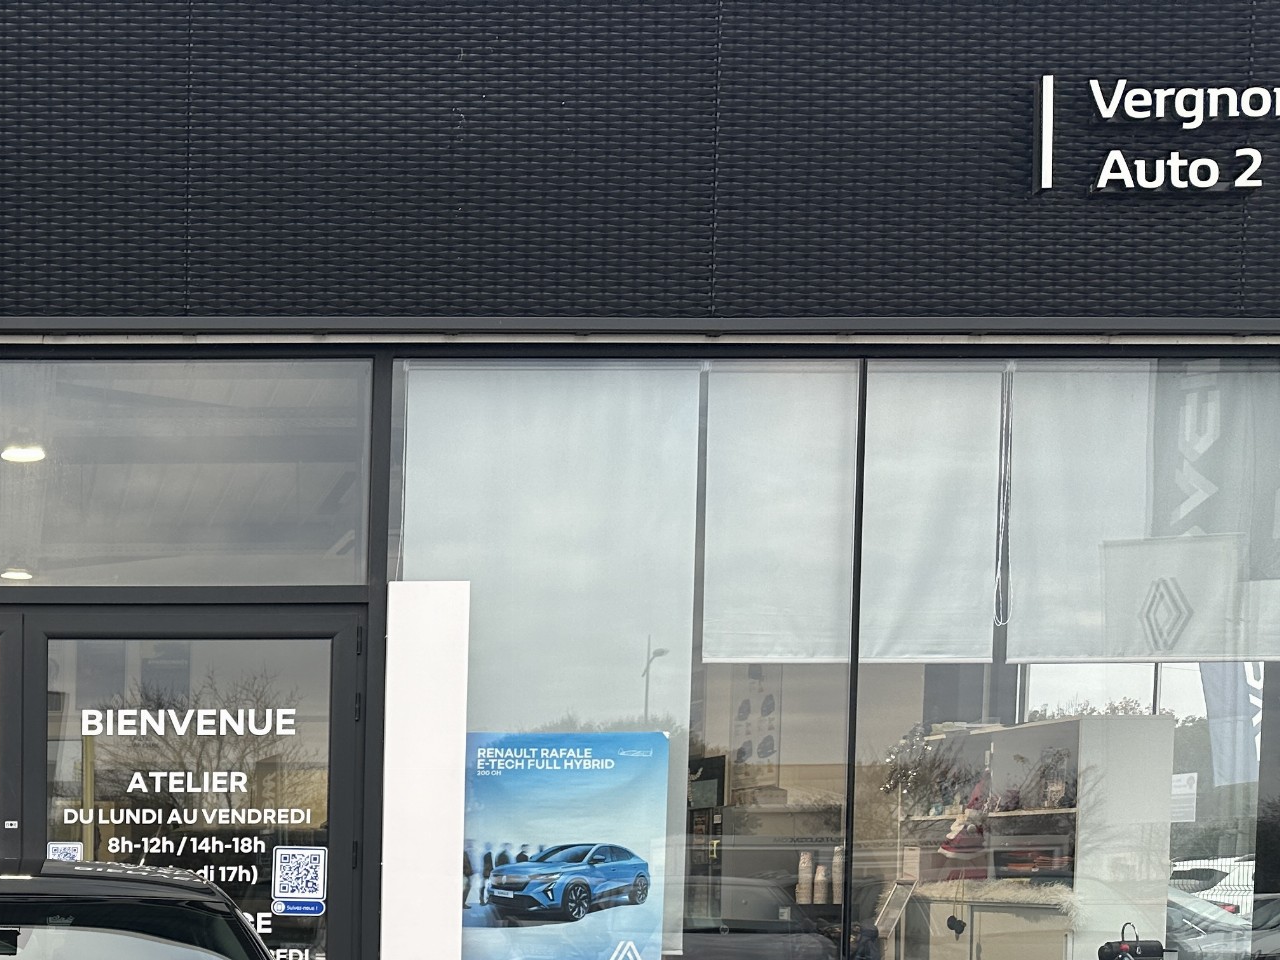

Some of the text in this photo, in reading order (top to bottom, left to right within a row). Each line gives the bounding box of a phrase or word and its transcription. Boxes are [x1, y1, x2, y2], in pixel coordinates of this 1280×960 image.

[1089, 79, 1280, 130] Vergno
[1096, 147, 1263, 189] Auto 2
[81, 708, 297, 737] BIENVENUE
[477, 747, 592, 758] RENAULT RAFALE
[477, 758, 615, 770] E-TECH FULL HYBRID
[126, 771, 248, 793] ATELIER
[63, 808, 311, 824] DU LUNDI AU VENDREDI
[108, 837, 266, 856] 8h-12h / 14h-18h
[220, 866, 258, 885] 17h)
